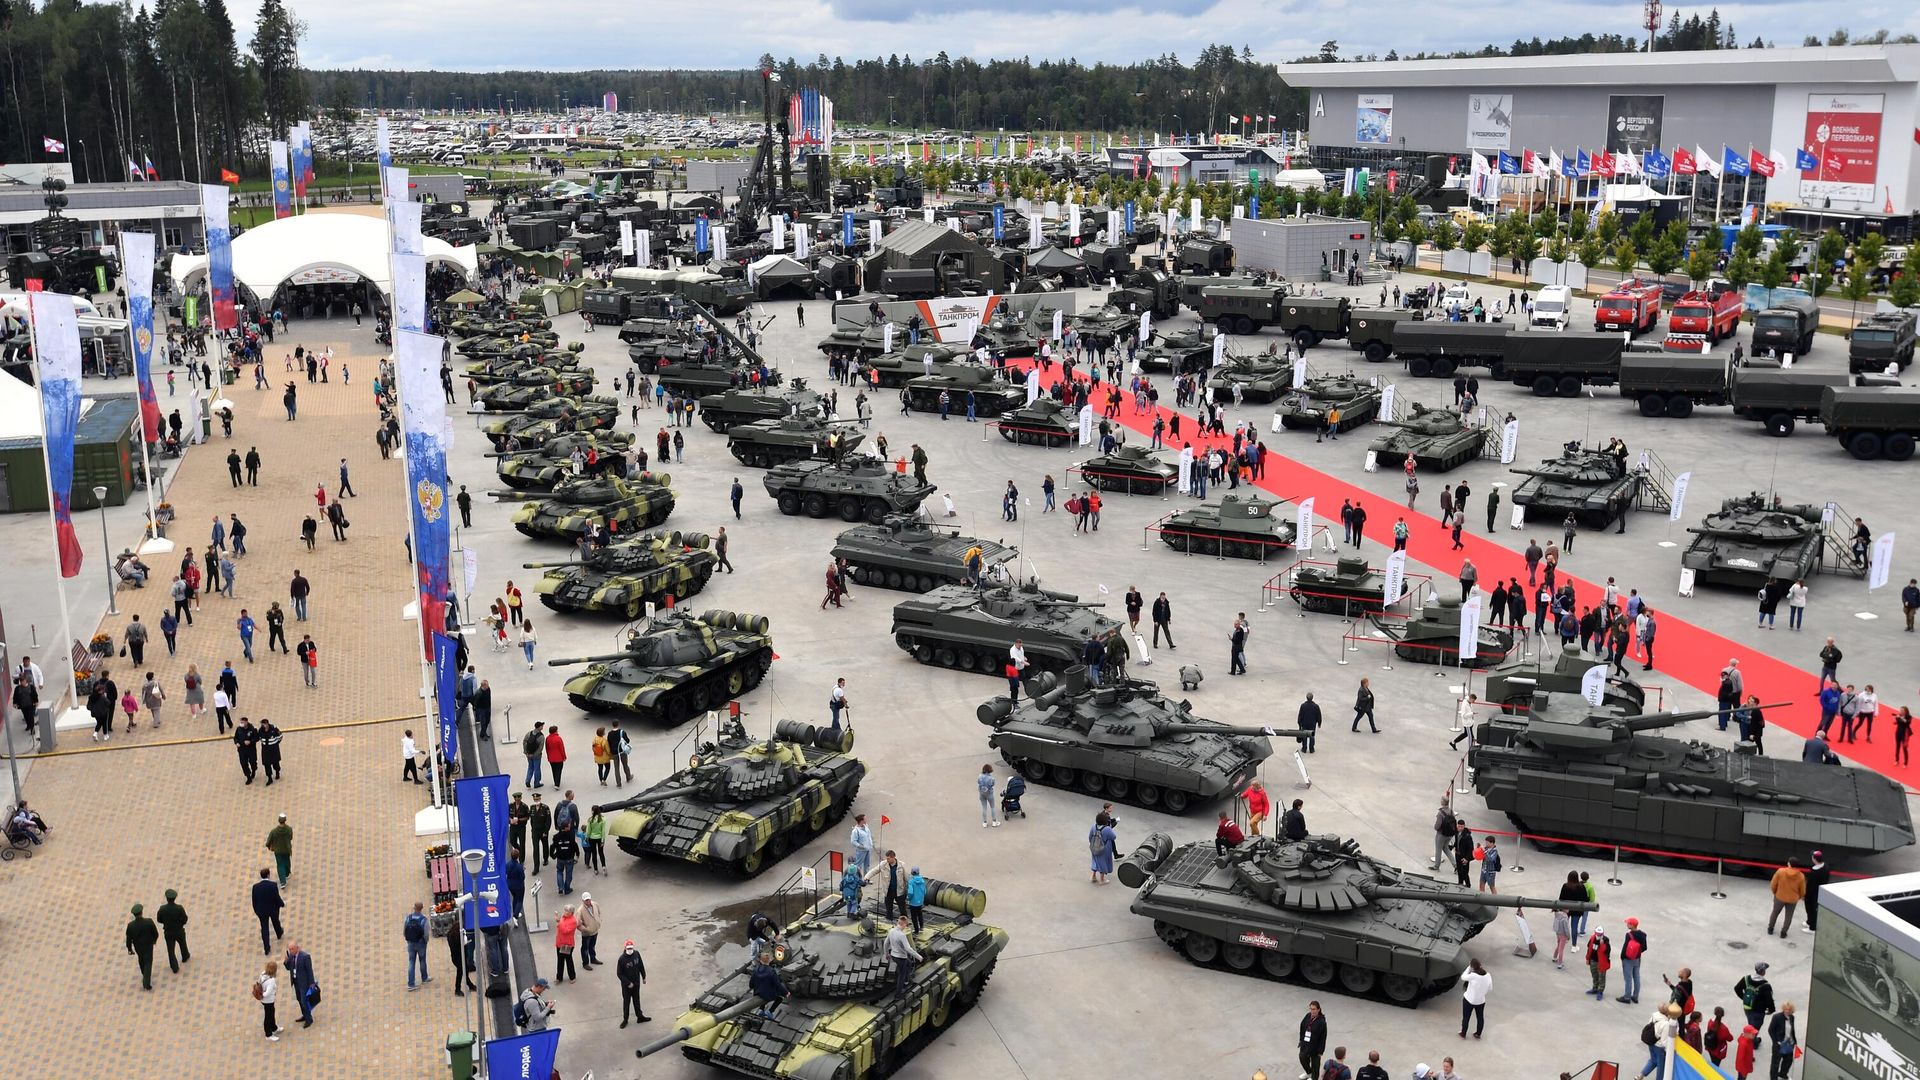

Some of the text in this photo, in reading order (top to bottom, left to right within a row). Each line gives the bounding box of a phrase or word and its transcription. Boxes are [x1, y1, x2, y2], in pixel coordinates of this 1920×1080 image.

[1314, 93, 1326, 117] A
[1627, 116, 1655, 125] ВЕРТОЛЕТЫ
[1832, 126, 1860, 134] ВОЕННЫЕ
[1830, 134, 1875, 143] ПЕРЕВОЗКИ.РФ
[938, 312, 980, 321] ТАНКПРОМ
[1248, 506, 1258, 515] 50
[1302, 513, 1310, 548] ТАНКПРОМ
[1589, 685, 1598, 705] ТАНК
[481, 786, 491, 813] людей
[484, 814, 494, 851] сильных
[487, 851, 495, 873] Банк
[1836, 1032, 1920, 1080] ТАНКПР
[1845, 1023, 1920, 1076] 100 ЛЕ
[520, 1045, 532, 1079] людей
